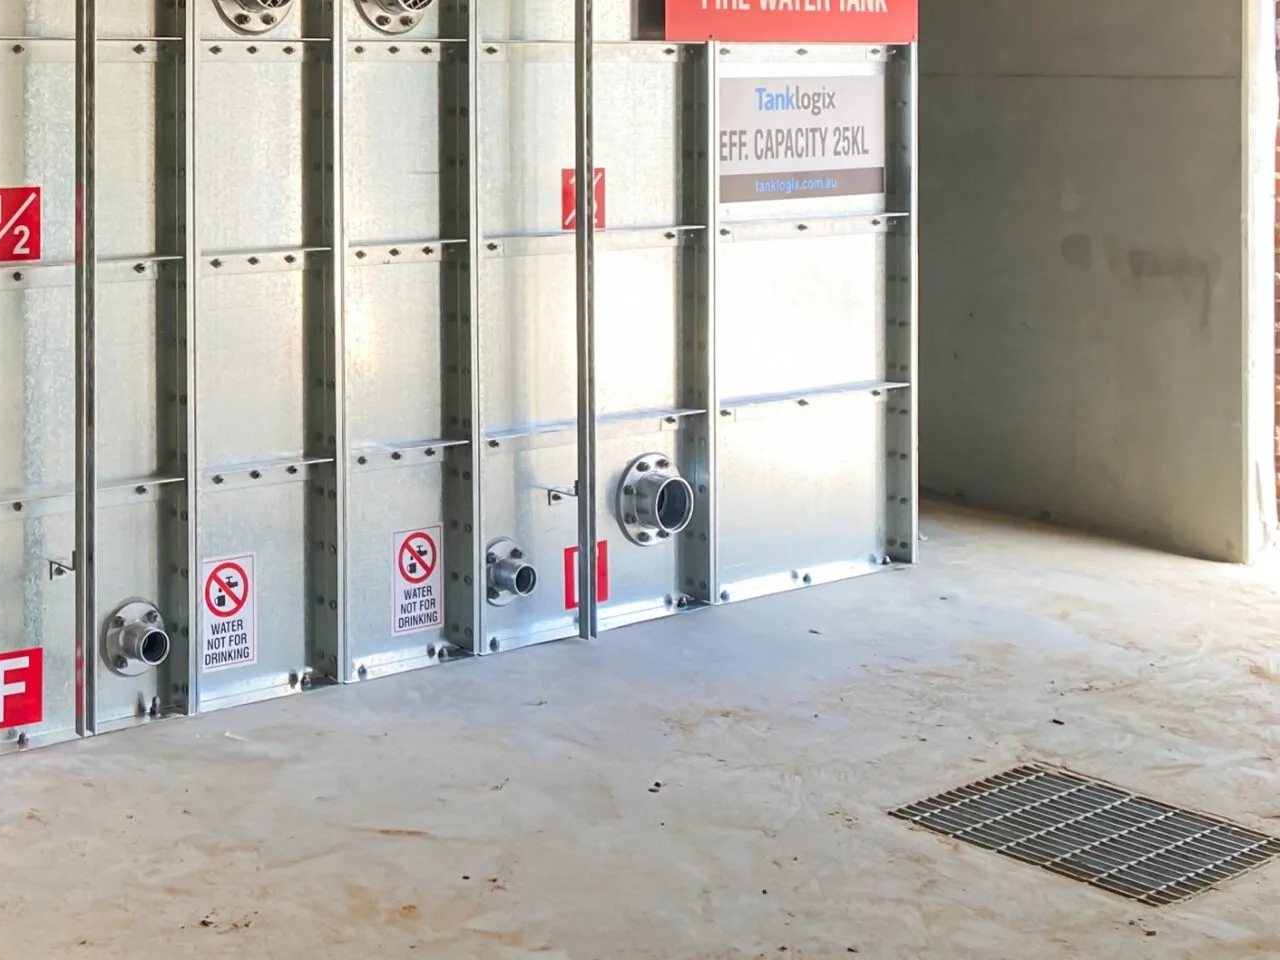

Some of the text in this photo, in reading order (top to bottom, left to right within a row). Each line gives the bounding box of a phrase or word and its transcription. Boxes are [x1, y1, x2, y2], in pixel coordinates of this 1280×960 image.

[755, 86, 836, 116] Tanklogix
[720, 126, 870, 161] EFF. CAPACITY 25KL
[404, 585, 433, 601] WATER
[400, 598, 436, 615] NOT FOR
[211, 619, 244, 636] WATER
[398, 611, 438, 629] DRINKING
[207, 633, 248, 651] NOT FOR
[204, 646, 250, 666] DRINKING
